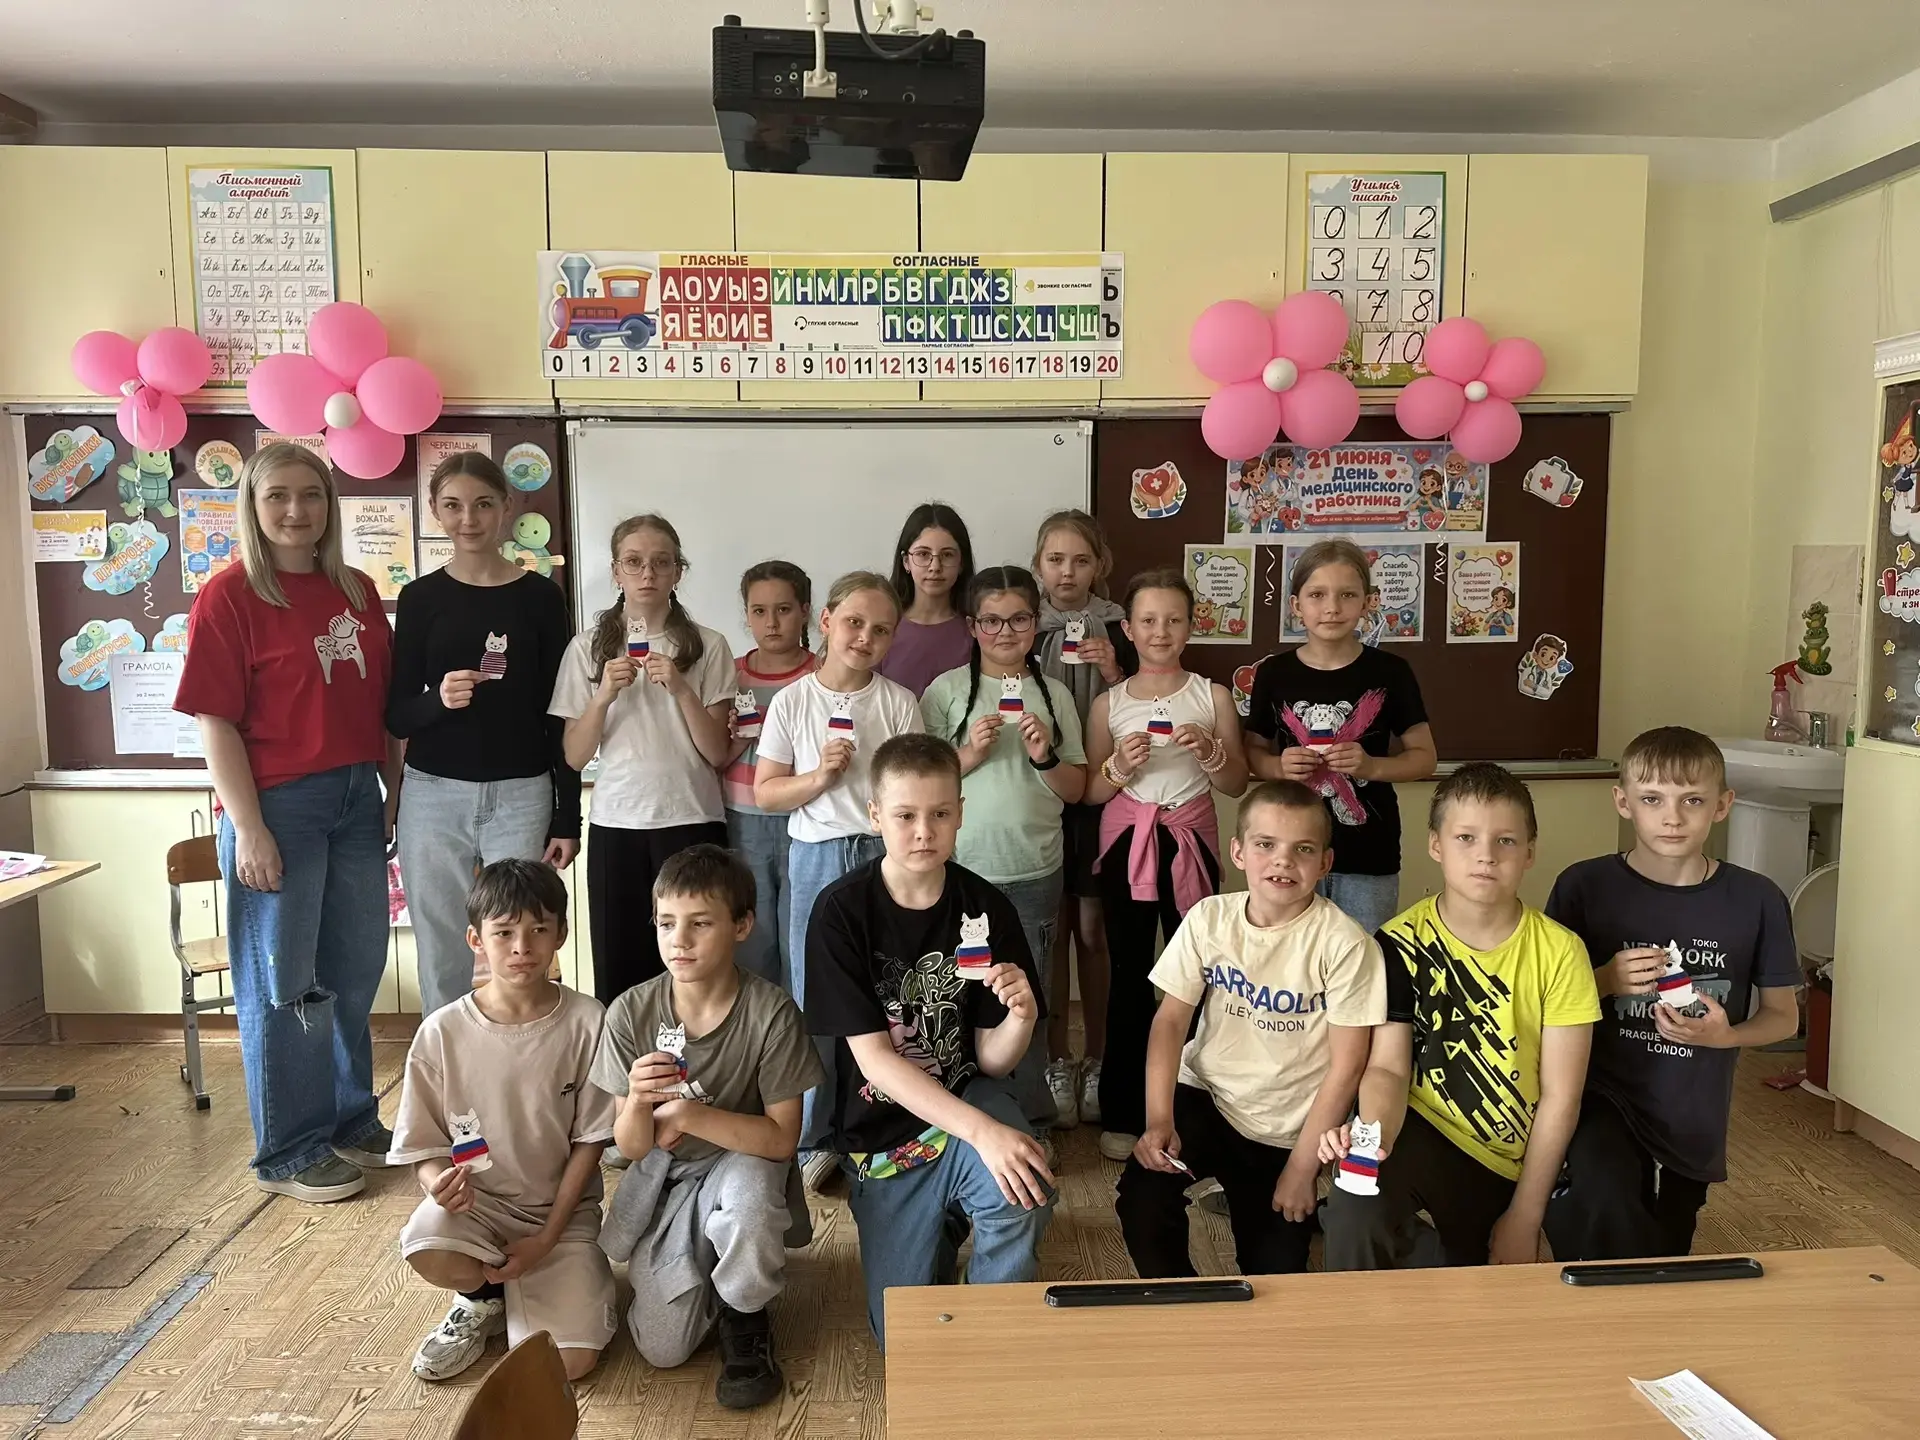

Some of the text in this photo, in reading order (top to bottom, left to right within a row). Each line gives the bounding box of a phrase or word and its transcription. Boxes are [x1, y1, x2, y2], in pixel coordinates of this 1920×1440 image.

[217, 174, 302, 186] Письменный
[1351, 178, 1401, 191] Учимся
[230, 187, 290, 200] алфавит
[1352, 192, 1398, 202] писать
[1324, 206, 1436, 238] 0 1 2
[681, 255, 748, 266] ГЛАСНЫЕ
[893, 256, 979, 266] СОГЛАСНЫЕ
[1321, 248, 1436, 281] 3 4 5
[1368, 290, 1389, 322] 7
[1412, 290, 1434, 322] 8
[552, 356, 1118, 373] 0 1 2 3 4 5 6 7 8 9 10 11 12 13 14 15 16 17 18 19 20
[294, 438, 324, 446] ОТРЯДА
[430, 441, 478, 450] ЧЕРЕПАШЬИ
[34, 434, 101, 494] ВКУСНЯШКИ
[1307, 450, 1392, 469] 21 июня
[1332, 467, 1378, 481] День
[1301, 482, 1413, 496] медицинского
[1315, 493, 1401, 512] работника
[356, 515, 395, 523] ВОЖАТЫЕ
[68, 633, 132, 678] КОНКУРСЫ
[123, 663, 172, 671] ГРАМОТА
[1692, 938, 1718, 948] TOKIO
[1253, 1017, 1305, 1032] LONDON
[1620, 1029, 1661, 1042] PRAGUE
[1647, 1042, 1693, 1058] LONDON
